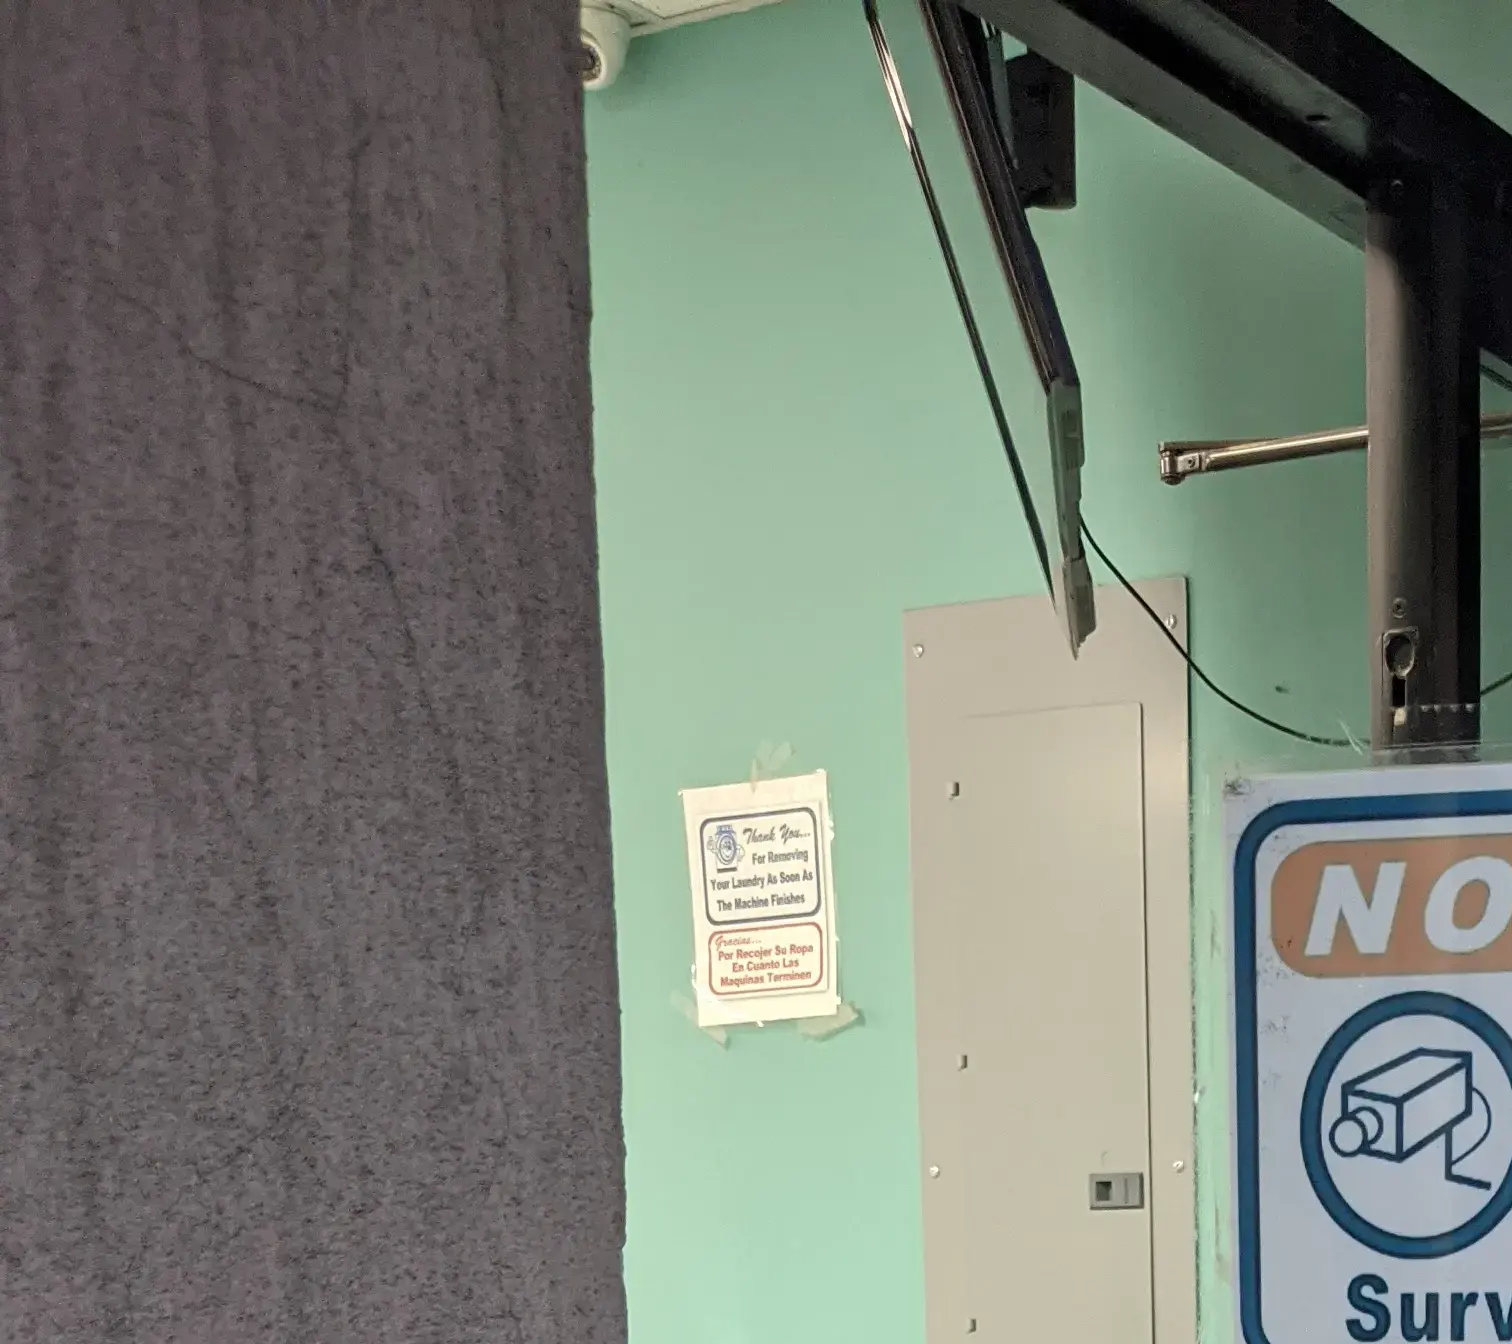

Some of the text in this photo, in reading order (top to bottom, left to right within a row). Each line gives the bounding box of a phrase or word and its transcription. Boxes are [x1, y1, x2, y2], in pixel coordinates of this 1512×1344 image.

[743, 827, 776, 845] Thank
[752, 848, 809, 866] For Removing
[710, 868, 813, 891] Your Laundry As Soon As
[716, 892, 805, 912] The Machine Finishes
[718, 943, 814, 962] Por Recojer Su Ropa
[732, 957, 800, 973] En Cuanto Las
[720, 970, 812, 988] Maquinas Terminen
